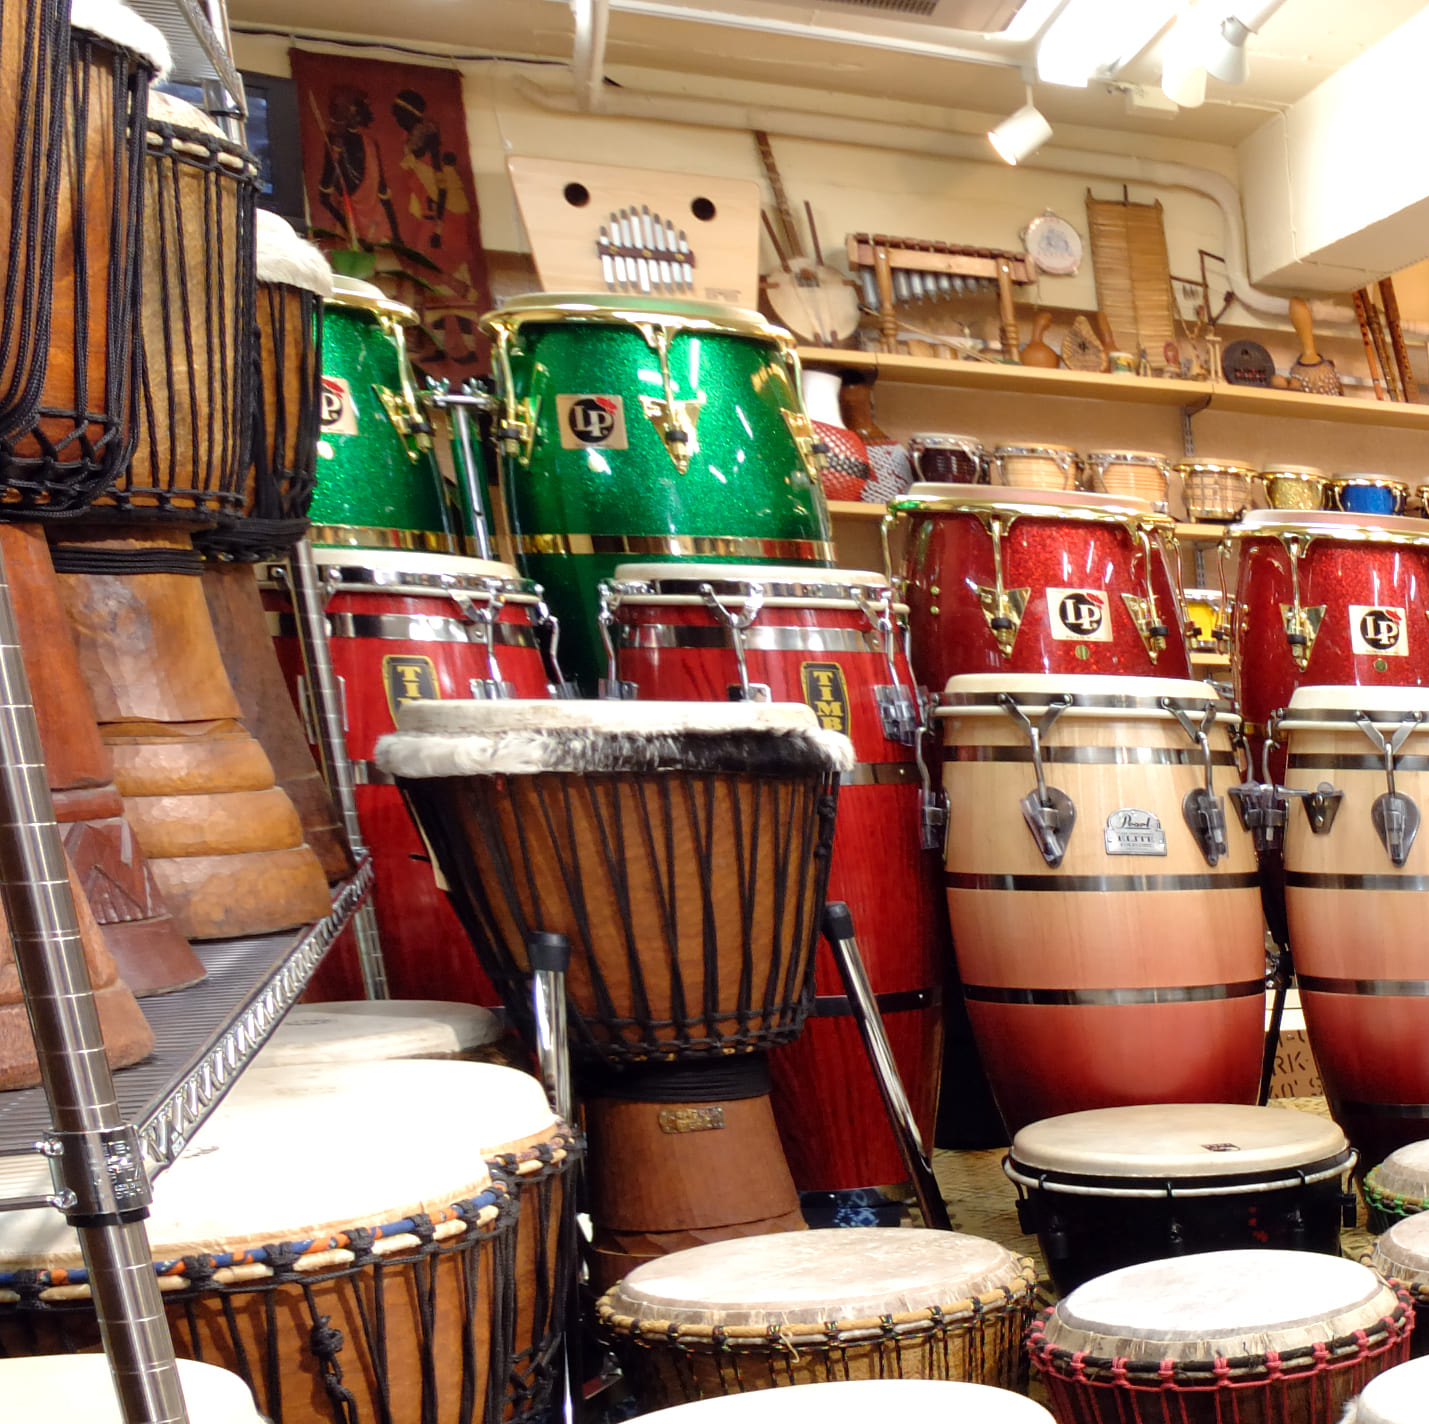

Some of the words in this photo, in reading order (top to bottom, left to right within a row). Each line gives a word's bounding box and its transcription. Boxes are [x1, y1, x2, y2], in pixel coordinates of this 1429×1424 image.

[575, 409, 613, 437] LP
[1064, 599, 1101, 630] LP
[1365, 615, 1399, 645] LP
[1120, 814, 1151, 829] Pearl
